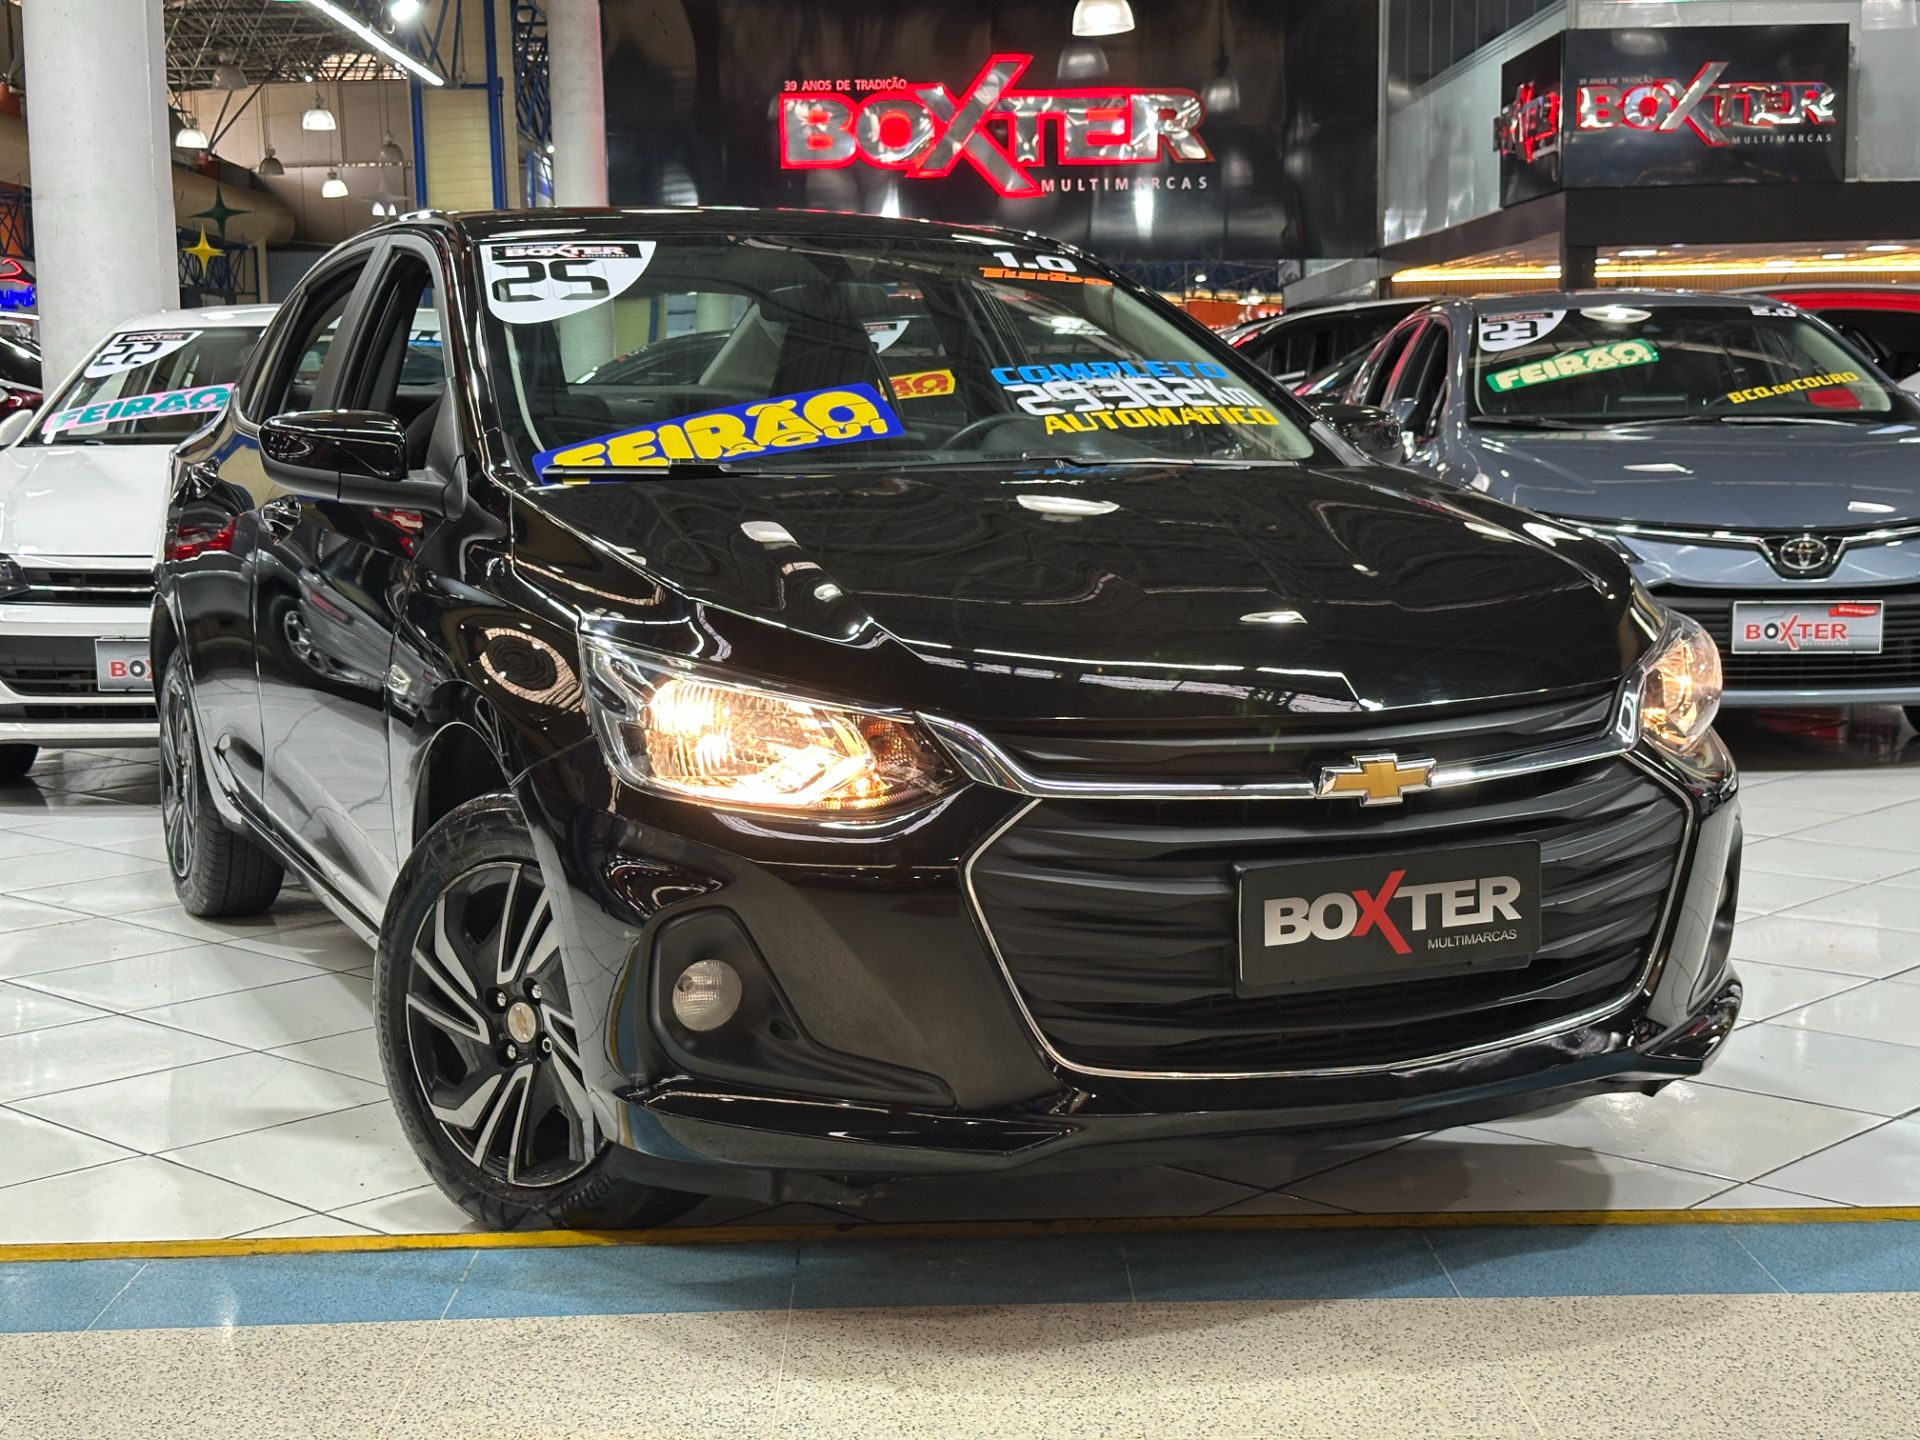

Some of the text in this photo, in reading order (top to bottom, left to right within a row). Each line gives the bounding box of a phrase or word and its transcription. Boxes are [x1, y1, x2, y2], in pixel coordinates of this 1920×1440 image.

[784, 76, 908, 92] 39 ANOS DE TRADIÇÃO
[1576, 61, 1837, 146] BOXTER
[778, 53, 1214, 198] BOXTER
[1731, 133, 1833, 145] MULTIMARCAS
[1040, 175, 1209, 193] MULTIMARCAS
[505, 244, 624, 258] BOXTER
[993, 252, 1077, 273] 1.0
[491, 260, 610, 303] 25
[1482, 321, 1539, 342] 23
[991, 360, 1230, 386] COMPLETO
[1495, 342, 1650, 390] FEIRÃO
[1791, 371, 1860, 390] COURO
[52, 387, 231, 429] FEIRÃO
[1743, 613, 1849, 651] BOXTER
[1263, 870, 1522, 954] BOXTER
[1427, 929, 1518, 950] MULTIMARCAS
